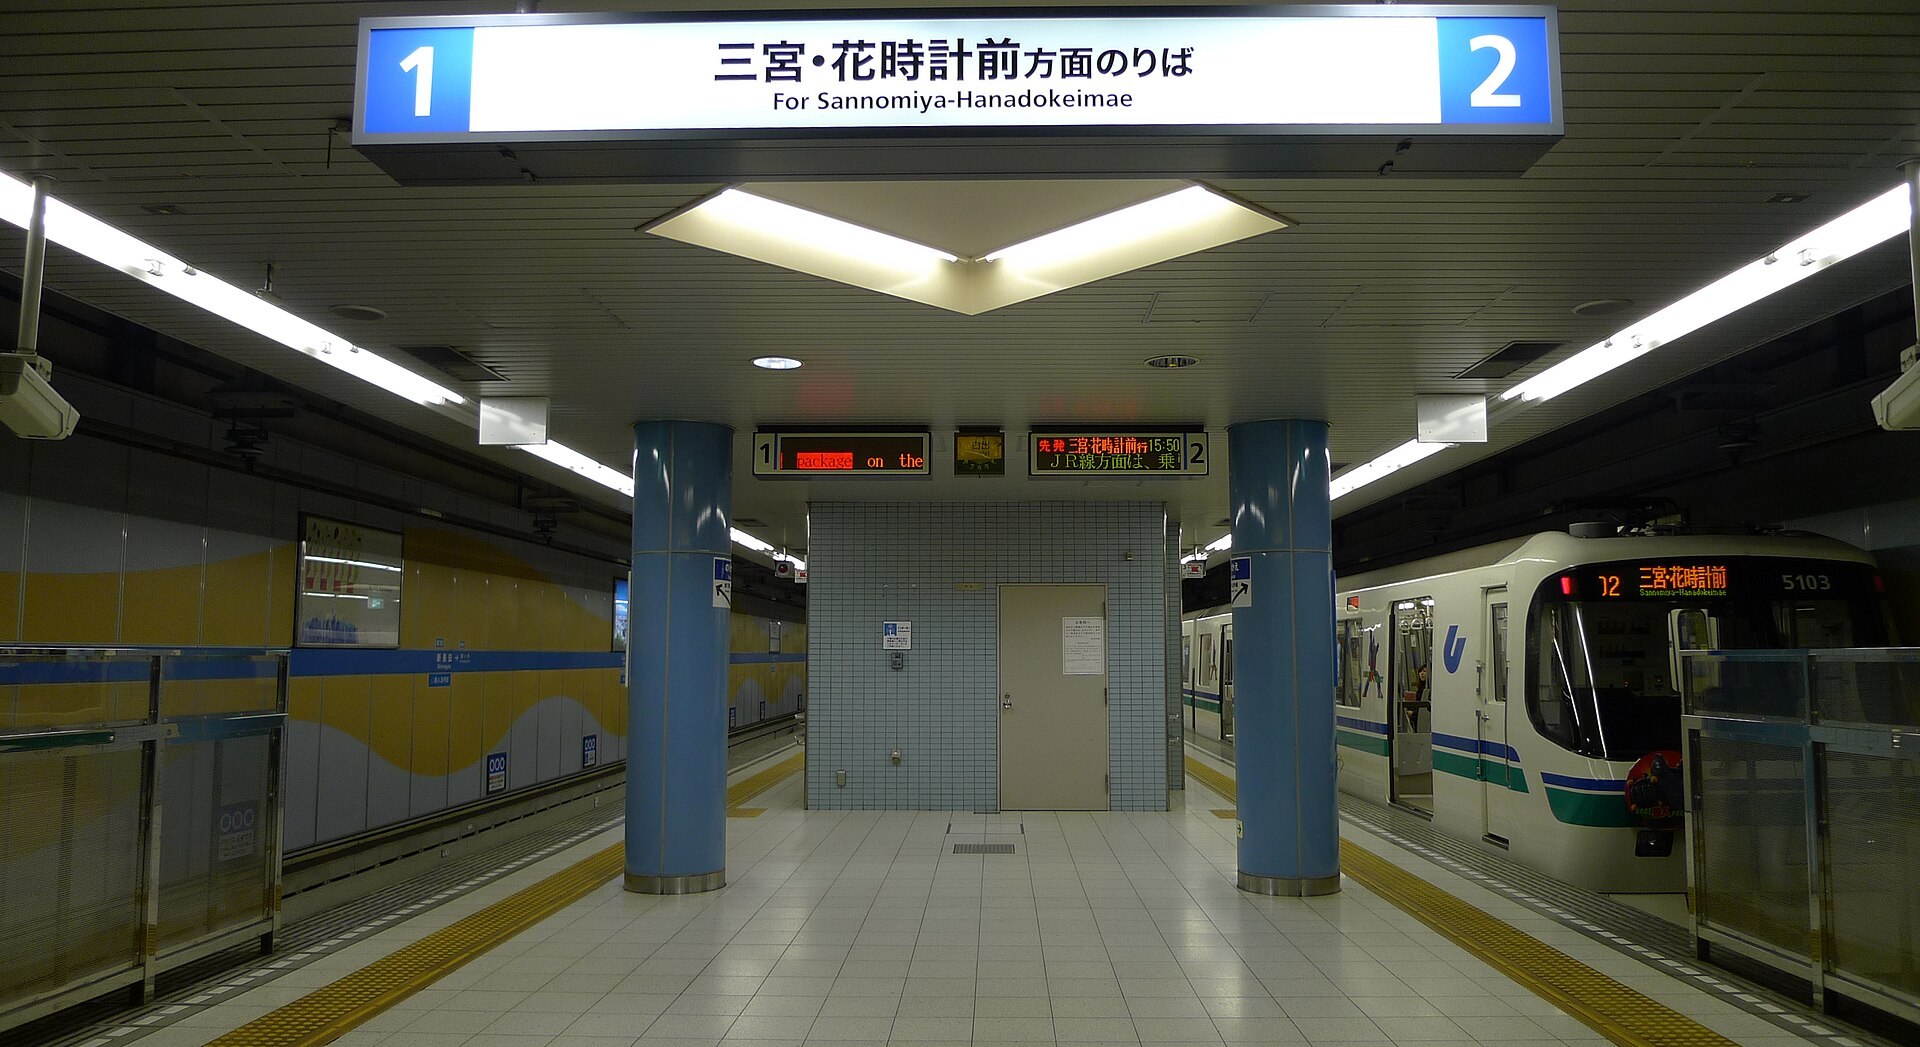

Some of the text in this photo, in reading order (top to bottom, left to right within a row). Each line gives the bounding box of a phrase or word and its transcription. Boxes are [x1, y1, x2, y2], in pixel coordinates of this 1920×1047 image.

[714, 37, 1195, 83] 三宮・花時計前方面のりば
[1468, 33, 1521, 107] 2
[398, 46, 435, 118] 1
[773, 89, 1133, 114] For Sannomiya-Hanadokeimae
[759, 442, 770, 464] 1
[1039, 438, 1065, 453] 先発
[1149, 438, 1180, 452] 15:50
[1190, 442, 1205, 464] 2
[797, 453, 924, 470] package on the
[1639, 564, 1727, 589] 三宮・花時計前
[1782, 574, 1832, 591] 5103
